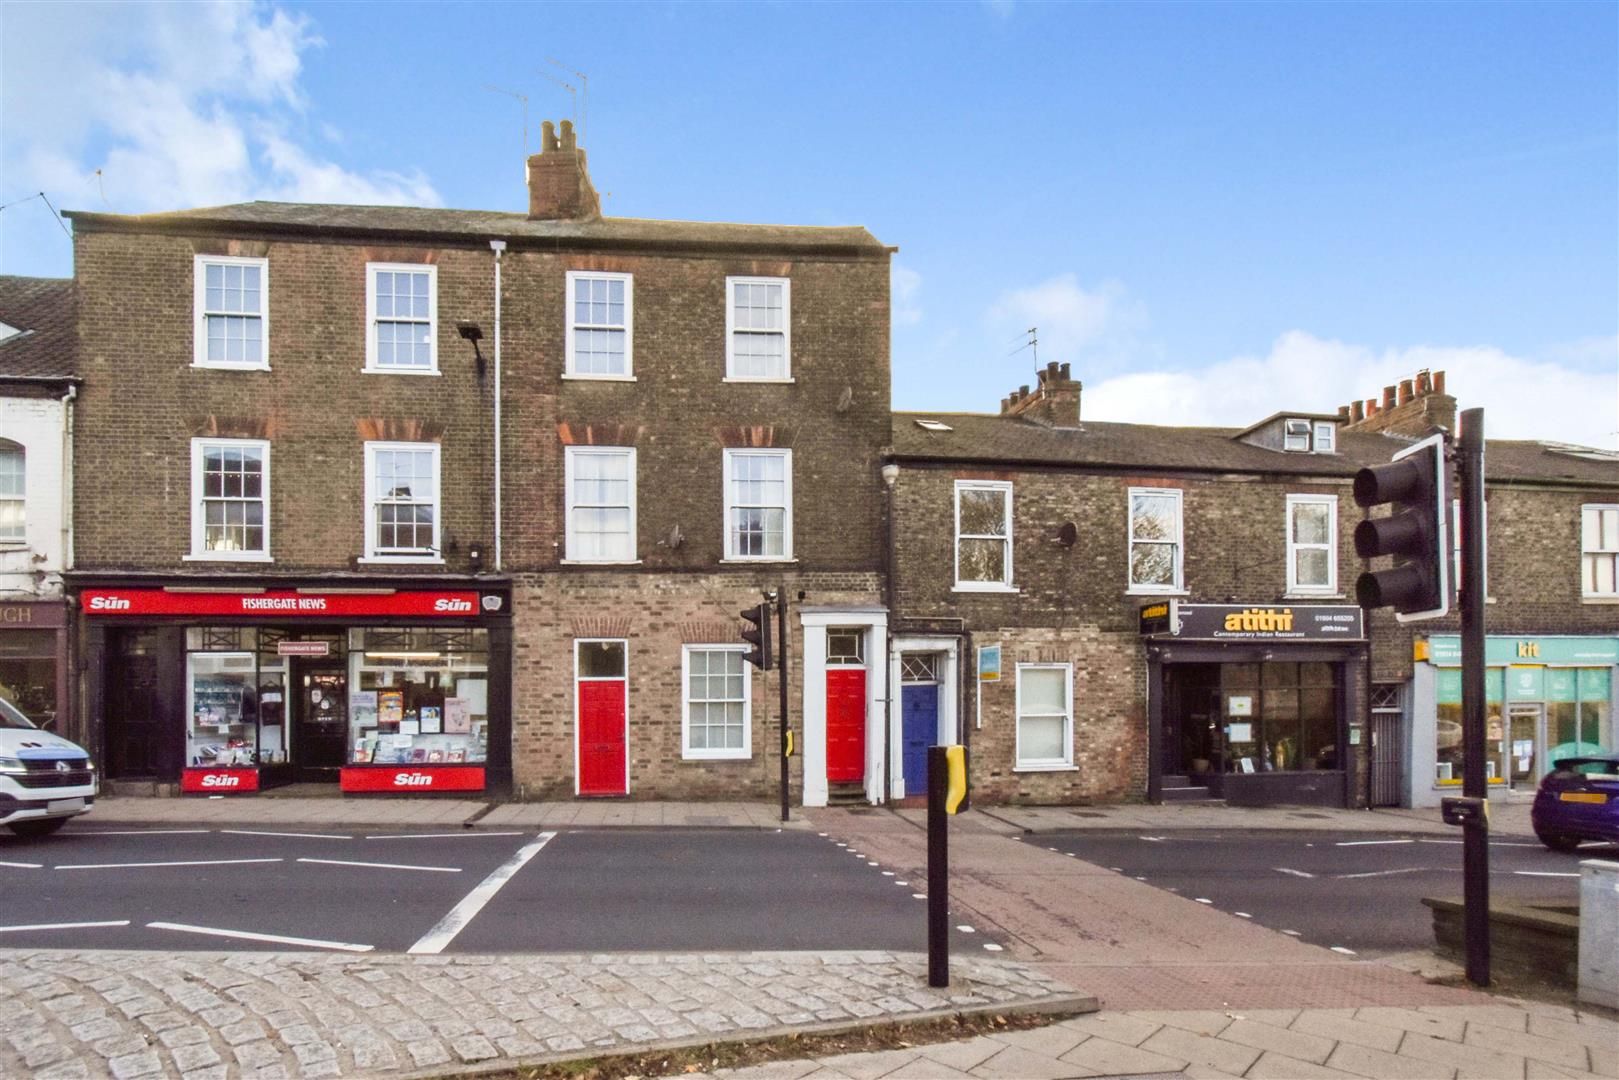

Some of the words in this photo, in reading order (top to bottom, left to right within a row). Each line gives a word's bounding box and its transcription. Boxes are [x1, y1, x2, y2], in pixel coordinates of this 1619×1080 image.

[242, 598, 297, 609] FISHERGATE
[299, 598, 326, 609] NEWS
[0, 607, 31, 622] GH
[1224, 608, 1293, 631] atithi
